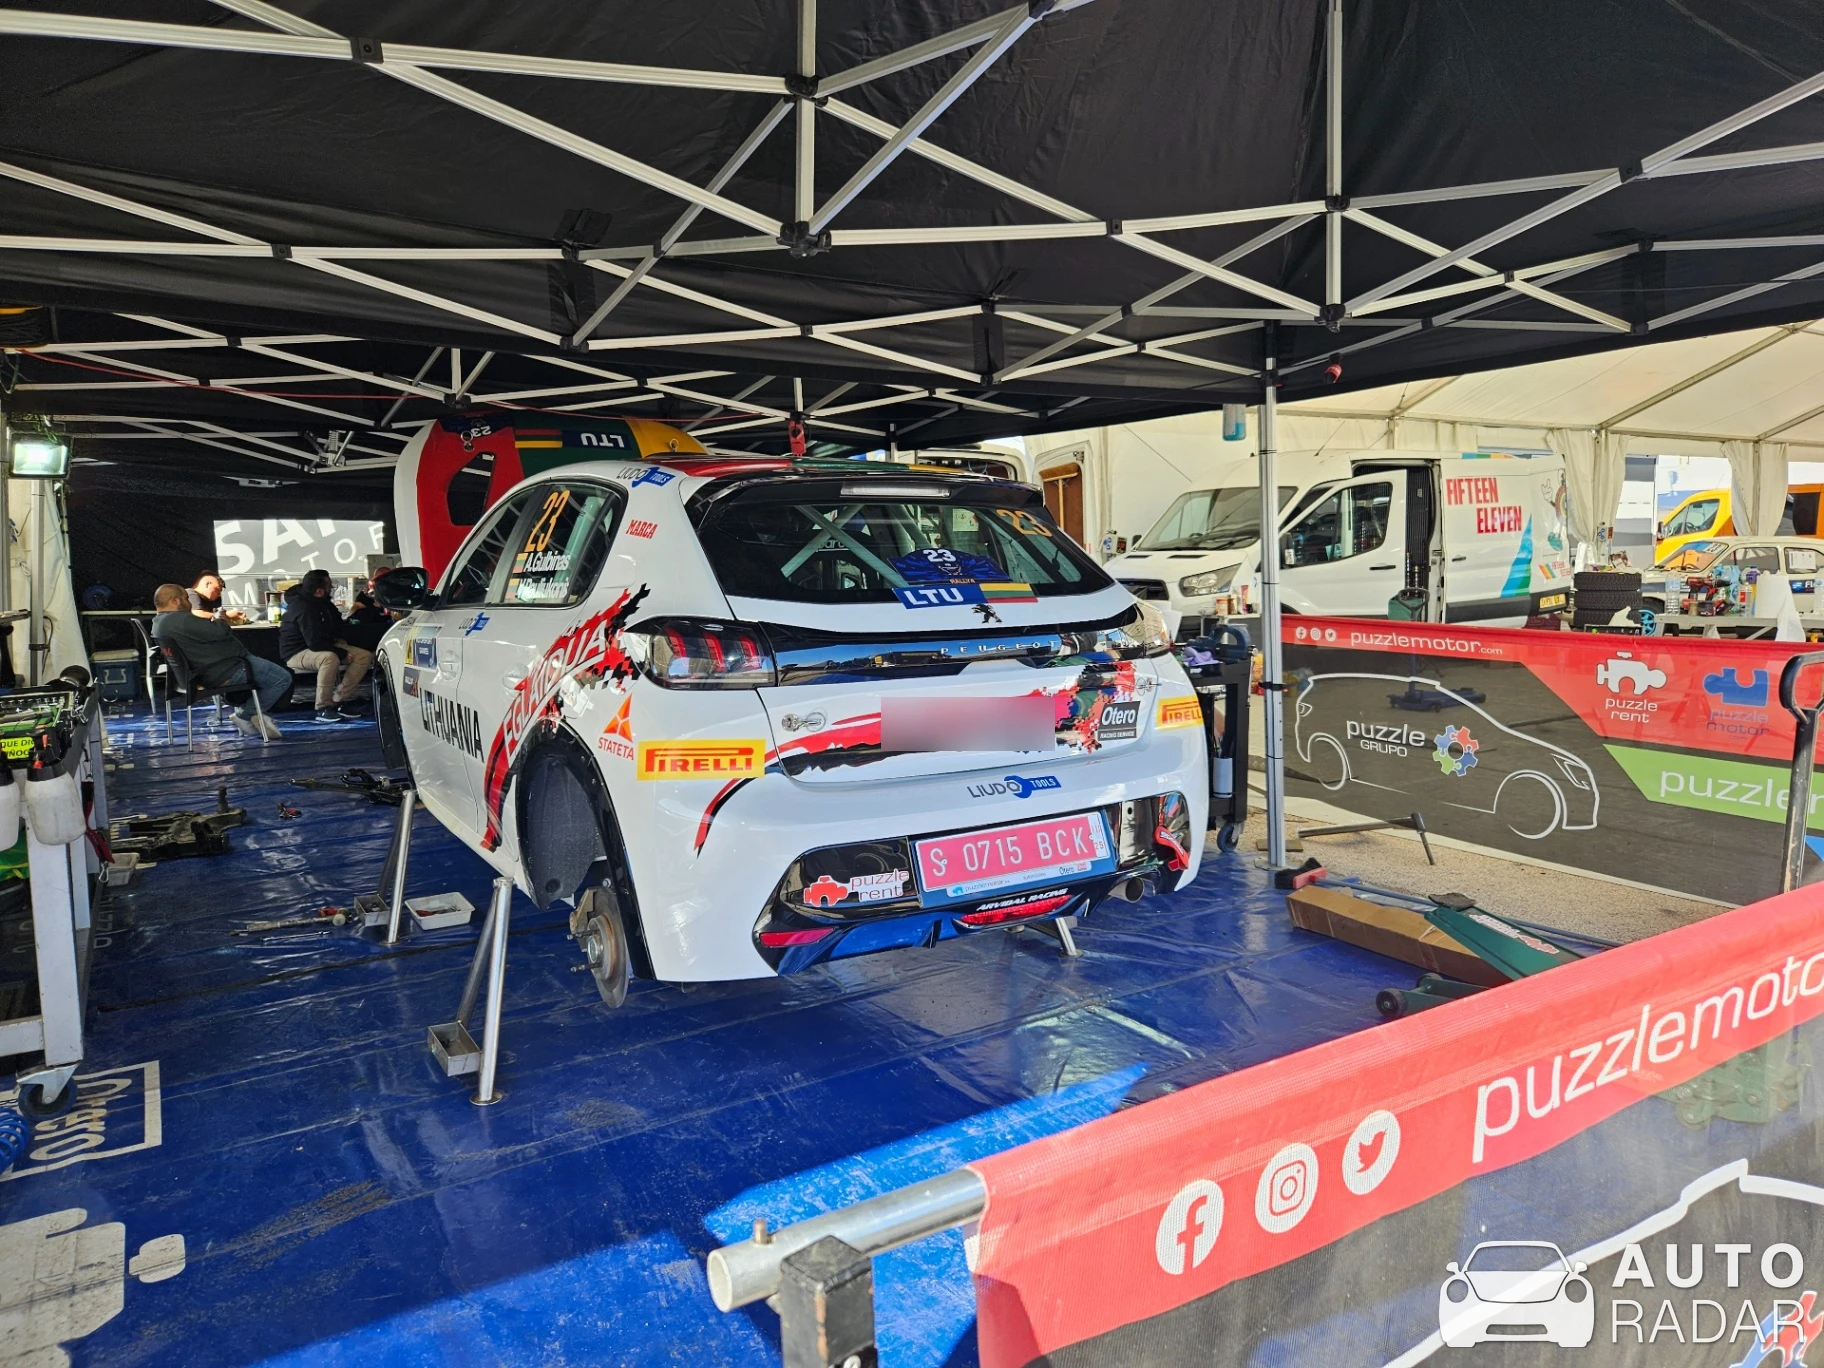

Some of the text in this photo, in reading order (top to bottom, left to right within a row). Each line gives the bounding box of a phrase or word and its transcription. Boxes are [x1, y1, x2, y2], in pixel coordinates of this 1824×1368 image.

[472, 425, 492, 438] 23
[580, 432, 626, 448] LTU
[616, 467, 671, 485] LIUDO TOOLS
[1446, 477, 1499, 505] FIFTEEN
[525, 489, 571, 552] 23
[626, 519, 659, 539] MARCA
[996, 508, 1053, 537] 23
[1476, 505, 1522, 534] ELEVEN
[923, 548, 957, 563] 23
[904, 587, 964, 605] LTU
[941, 640, 1057, 655] PEUGEOT
[1351, 631, 1503, 655] puzzlemotor.com
[1605, 698, 1658, 713] puzzle
[419, 687, 485, 763] LITHUANIA
[1101, 706, 1136, 726] Otero
[1610, 709, 1650, 723] rent
[1710, 709, 1769, 724] puzzle
[1346, 719, 1426, 747] puzzle
[1706, 721, 1770, 736] motor
[598, 736, 634, 761] STATETA
[1360, 739, 1408, 757] GRUPO
[645, 747, 754, 772] PIRELLI
[967, 777, 1057, 799] LIUDO TOOLS
[929, 826, 1089, 877] S 0715 BCK
[851, 868, 909, 891] puzzle
[860, 885, 903, 901] rent
[976, 888, 1069, 911] ARVIDAL RACING
